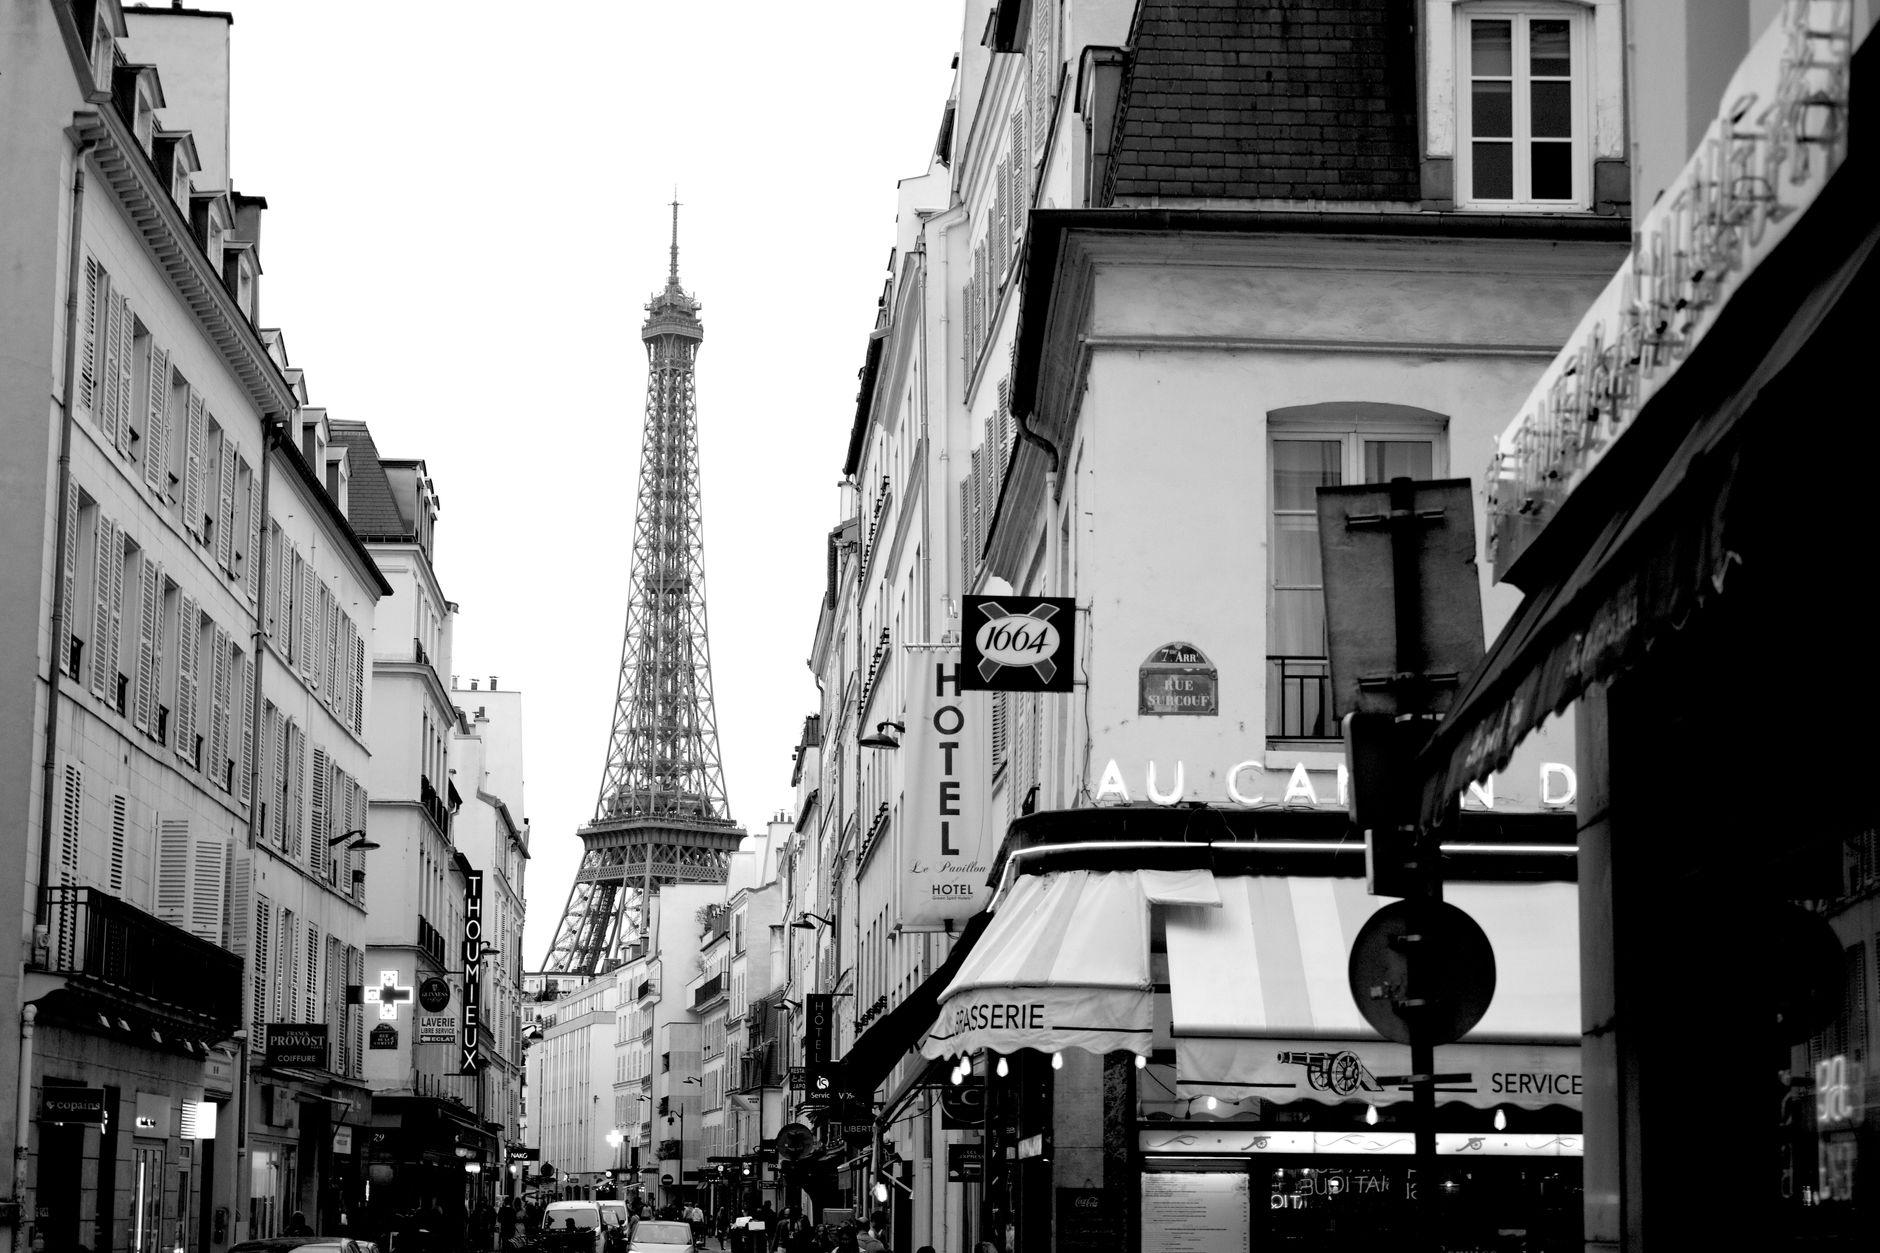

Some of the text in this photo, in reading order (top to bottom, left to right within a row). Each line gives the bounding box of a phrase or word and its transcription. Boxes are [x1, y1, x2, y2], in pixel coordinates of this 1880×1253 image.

[984, 621, 1053, 654] 1664
[1164, 680, 1194, 691] RUE
[1147, 695, 1210, 707] SURCOUF
[933, 662, 965, 856] HOTEL
[1096, 758, 1184, 806] AU
[910, 861, 986, 874] Le Pavillon
[932, 884, 973, 895] HOTEL
[463, 876, 481, 1070] THOUMIEUX
[421, 1017, 455, 1027] LAVERIE
[955, 1004, 1045, 1035] BRASSERIE
[270, 1035, 326, 1047] PROVOST
[277, 1054, 316, 1062] COIFFURE
[1491, 1073, 1583, 1095] SERVICE
[56, 1099, 101, 1111] copains
